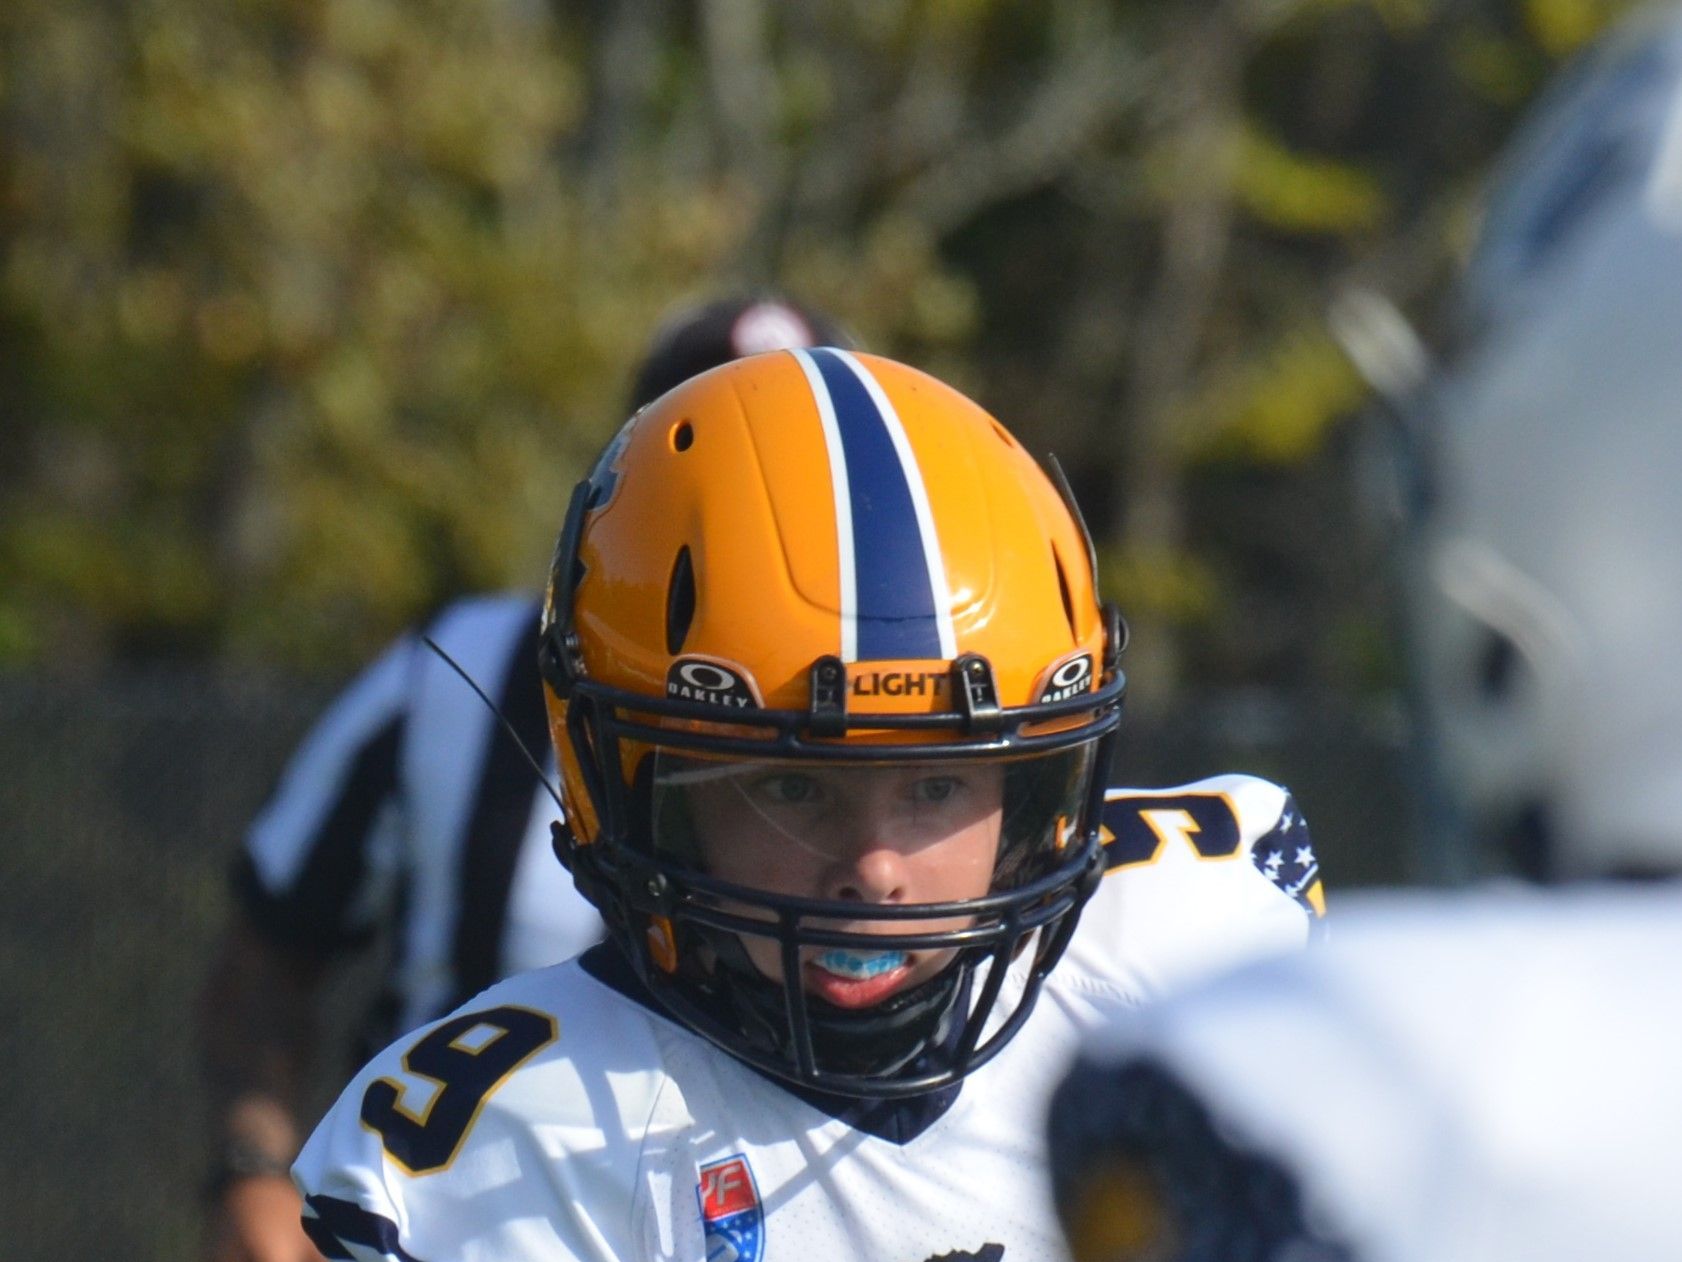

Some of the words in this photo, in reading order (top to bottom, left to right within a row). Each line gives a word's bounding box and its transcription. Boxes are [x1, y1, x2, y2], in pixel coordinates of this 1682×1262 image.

[668, 682, 748, 708] OAKLEY
[853, 673, 946, 696] LIGHT
[359, 1005, 560, 1178] 9
